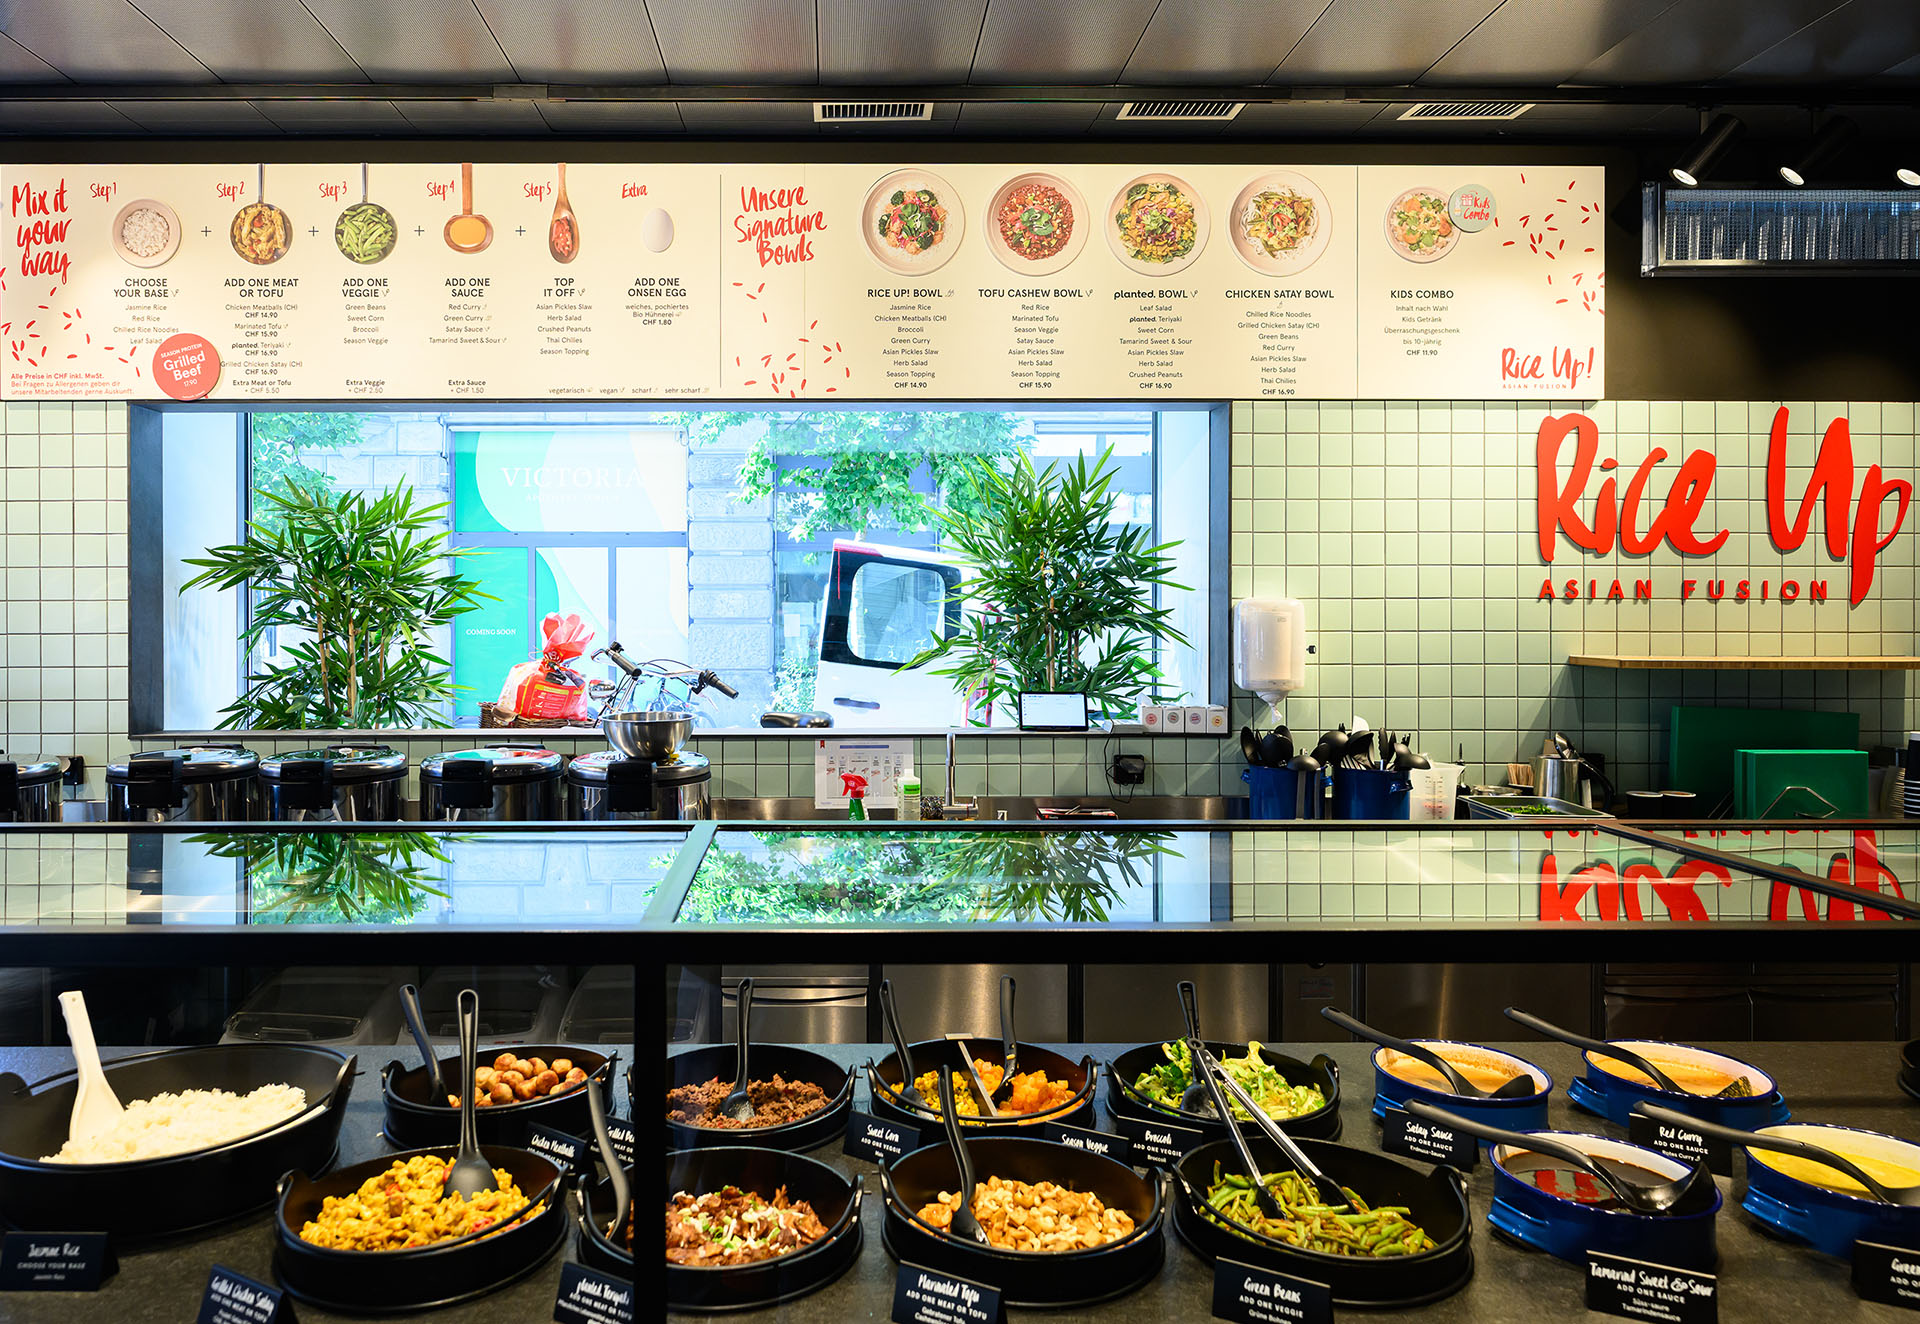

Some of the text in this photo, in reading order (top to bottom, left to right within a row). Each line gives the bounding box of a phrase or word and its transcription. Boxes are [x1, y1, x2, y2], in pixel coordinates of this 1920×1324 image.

[12, 178, 68, 217] Mix it
[622, 182, 648, 198] Extra
[741, 186, 808, 212] Unsere
[1474, 196, 1490, 209] Kids
[1464, 207, 1490, 221] Combo
[734, 208, 827, 253] Signature
[17, 219, 72, 259] your
[759, 234, 814, 267] Bowls
[22, 251, 72, 284] way
[125, 278, 168, 288] CHOOSE
[224, 279, 300, 288] ADD ONE MEAT
[343, 278, 389, 287] ADD ONE
[445, 278, 491, 287] ADD ONE
[554, 278, 575, 287] TOP
[635, 278, 680, 287] ADD ONE
[114, 289, 169, 298] YOUR BASE
[240, 289, 284, 298] OR TOFU
[342, 289, 380, 298] VEGGIE
[452, 289, 484, 298] SAUCE
[544, 289, 576, 298] IT OFF
[628, 288, 687, 298] ONSEN EGG
[868, 289, 943, 298] RICE UP! BOWL
[978, 289, 1084, 298] TOFU CASHEW BOWL
[1114, 290, 1189, 301] planted. BOWL
[1226, 290, 1335, 299] CHICKEN SATAY BOWL
[1391, 290, 1455, 299] KIDS COMBO
[1159, 316, 1183, 324] Teriyaki
[912, 338, 931, 346] Curry
[163, 351, 206, 371] Grilled
[1501, 345, 1594, 390] Rice Up!
[173, 363, 202, 381] Beef
[1537, 406, 1913, 606] Rice Up
[1538, 578, 1829, 601] ASIAN FUSION
[866, 1123, 899, 1143] Sweet Corn
[1145, 1129, 1172, 1145] Broccoli
[1406, 1121, 1453, 1142] Satay Sauce
[1659, 1126, 1703, 1147] Red Curry
[1061, 1133, 1108, 1155] Season Veggie
[1589, 1262, 1636, 1283] Tamarind
[1638, 1270, 1669, 1290] Sweet
[1688, 1279, 1714, 1297] Sour
[961, 1283, 980, 1308] Tofu
[1243, 1276, 1301, 1304] Green Beans
[1617, 1283, 1686, 1305] ADD ONE SAUCE
[906, 1289, 920, 1300] ADD
[921, 1294, 936, 1305] ONE
[937, 1298, 955, 1310] MEAT
[1239, 1295, 1255, 1305] ADD
[1256, 1299, 1273, 1310] ONE
